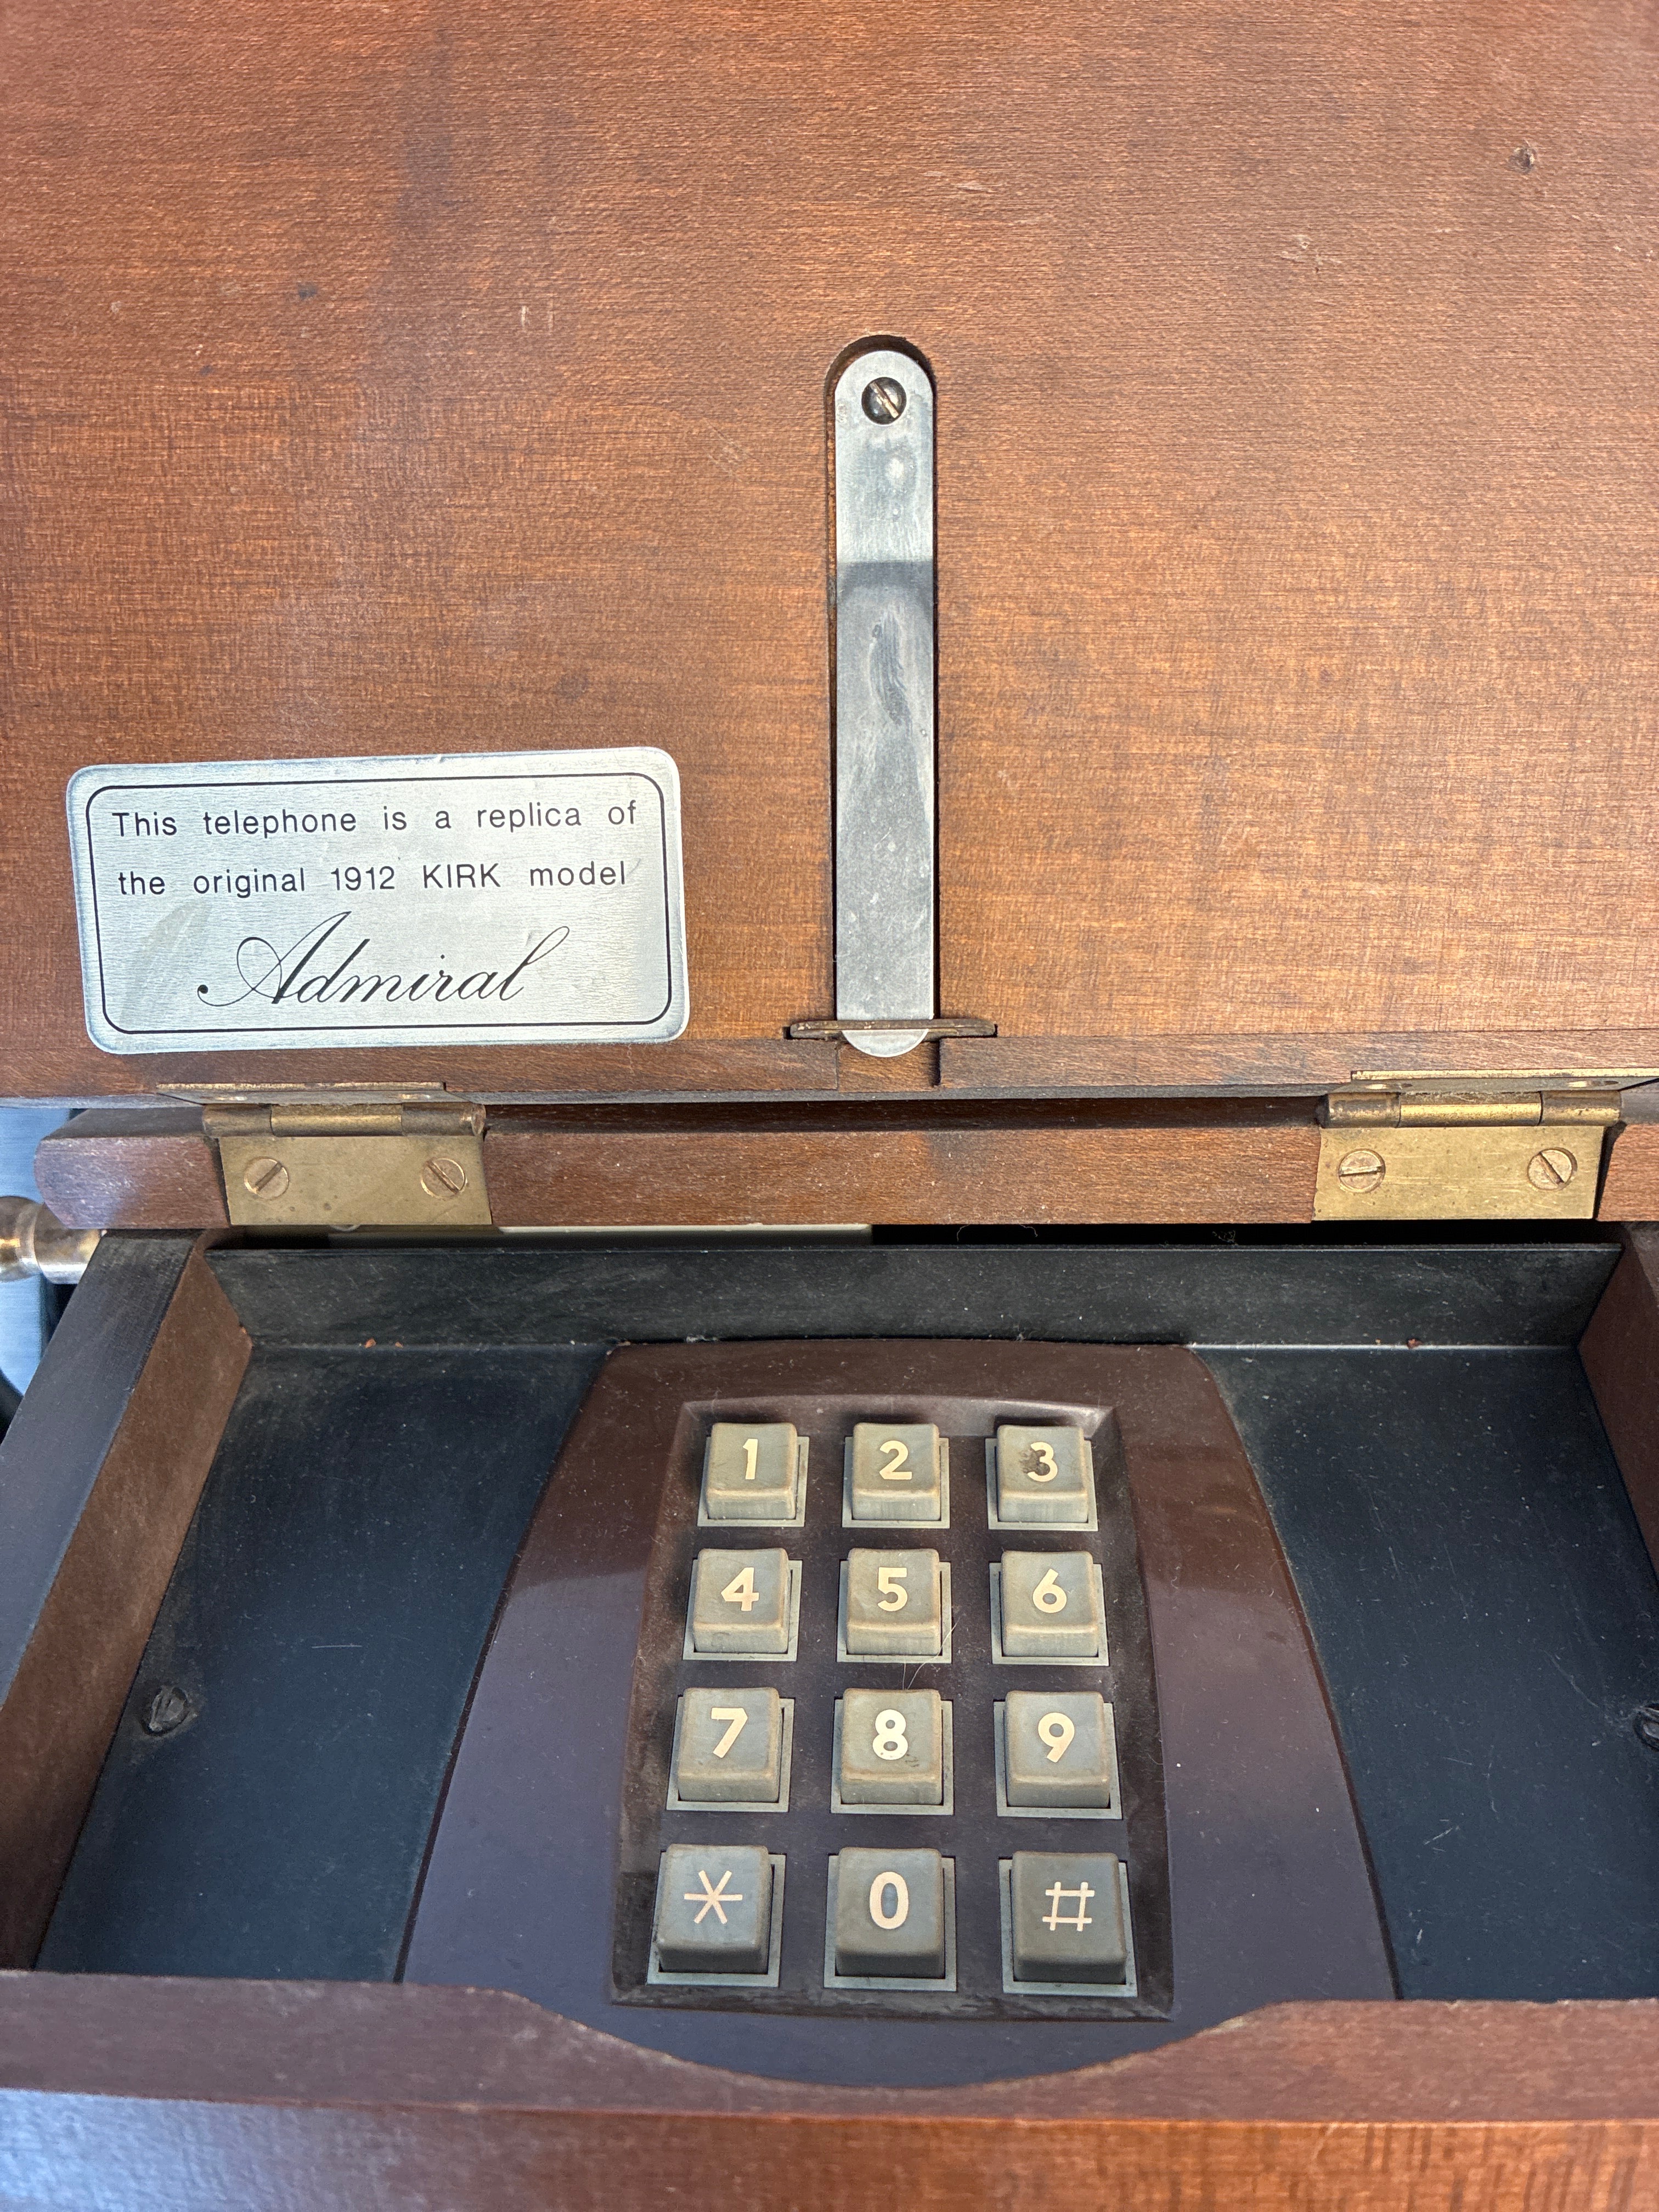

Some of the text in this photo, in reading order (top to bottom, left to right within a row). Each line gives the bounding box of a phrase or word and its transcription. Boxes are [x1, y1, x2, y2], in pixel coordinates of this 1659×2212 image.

[111, 800, 636, 839] This telephone is a replica of
[118, 861, 625, 899] the original 1912 KIRK model
[197, 911, 569, 1007] Admiral
[742, 1438, 758, 1480] 1
[879, 1440, 912, 1480] 2
[1027, 1441, 1058, 1482] 3
[720, 1567, 759, 1611] 4
[877, 1567, 908, 1612] 5
[1032, 1568, 1067, 1613] 6
[710, 1707, 748, 1758] 7
[872, 1709, 909, 1760] 8
[1037, 1712, 1075, 1763] 9
[869, 1871, 909, 1929] 0
